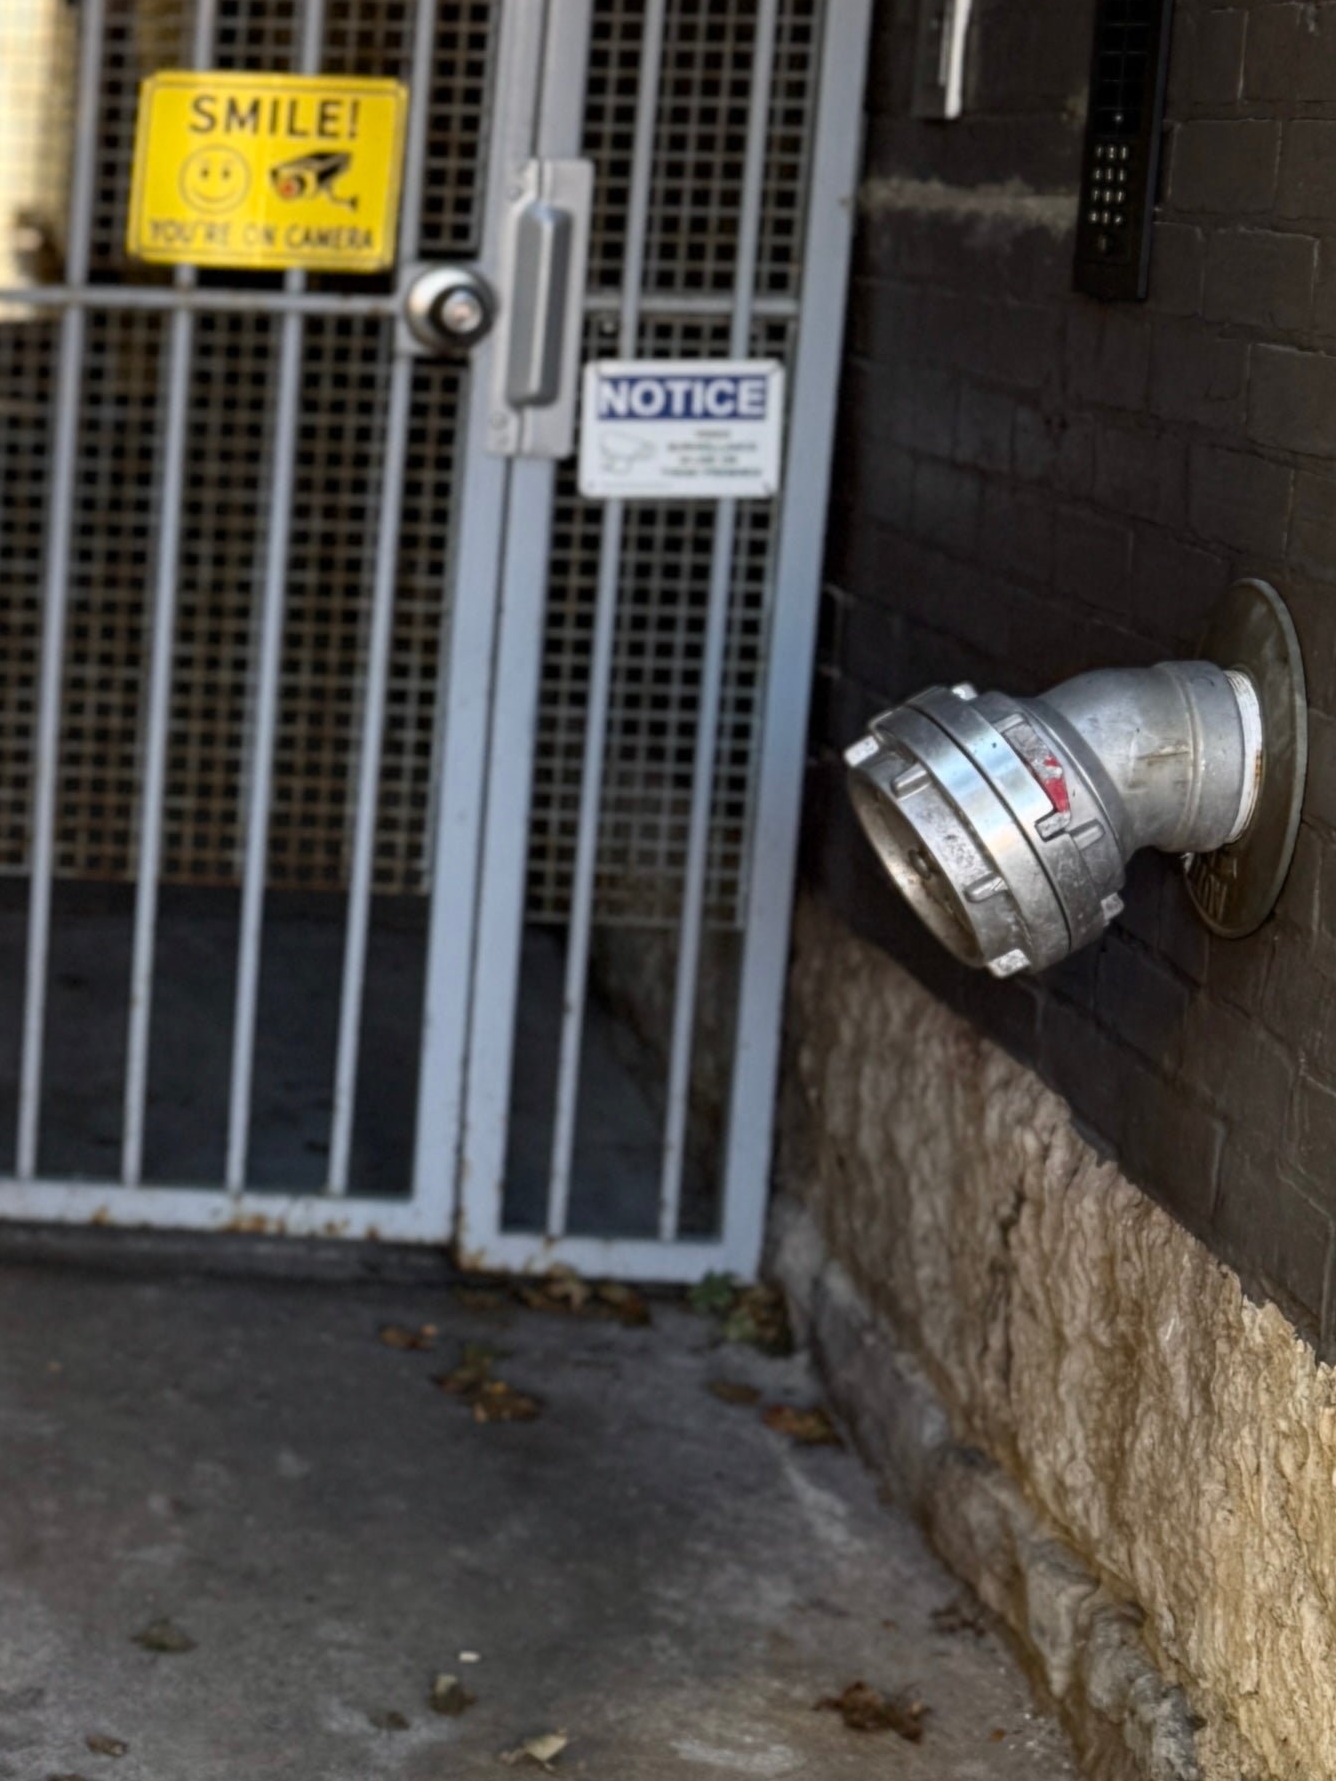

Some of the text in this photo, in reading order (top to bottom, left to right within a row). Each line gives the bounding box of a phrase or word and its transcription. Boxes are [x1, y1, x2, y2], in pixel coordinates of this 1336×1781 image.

[189, 95, 359, 139] SMILE!
[149, 220, 373, 250] YOU'RE ON CAMERA
[600, 380, 765, 416] NOTICE
